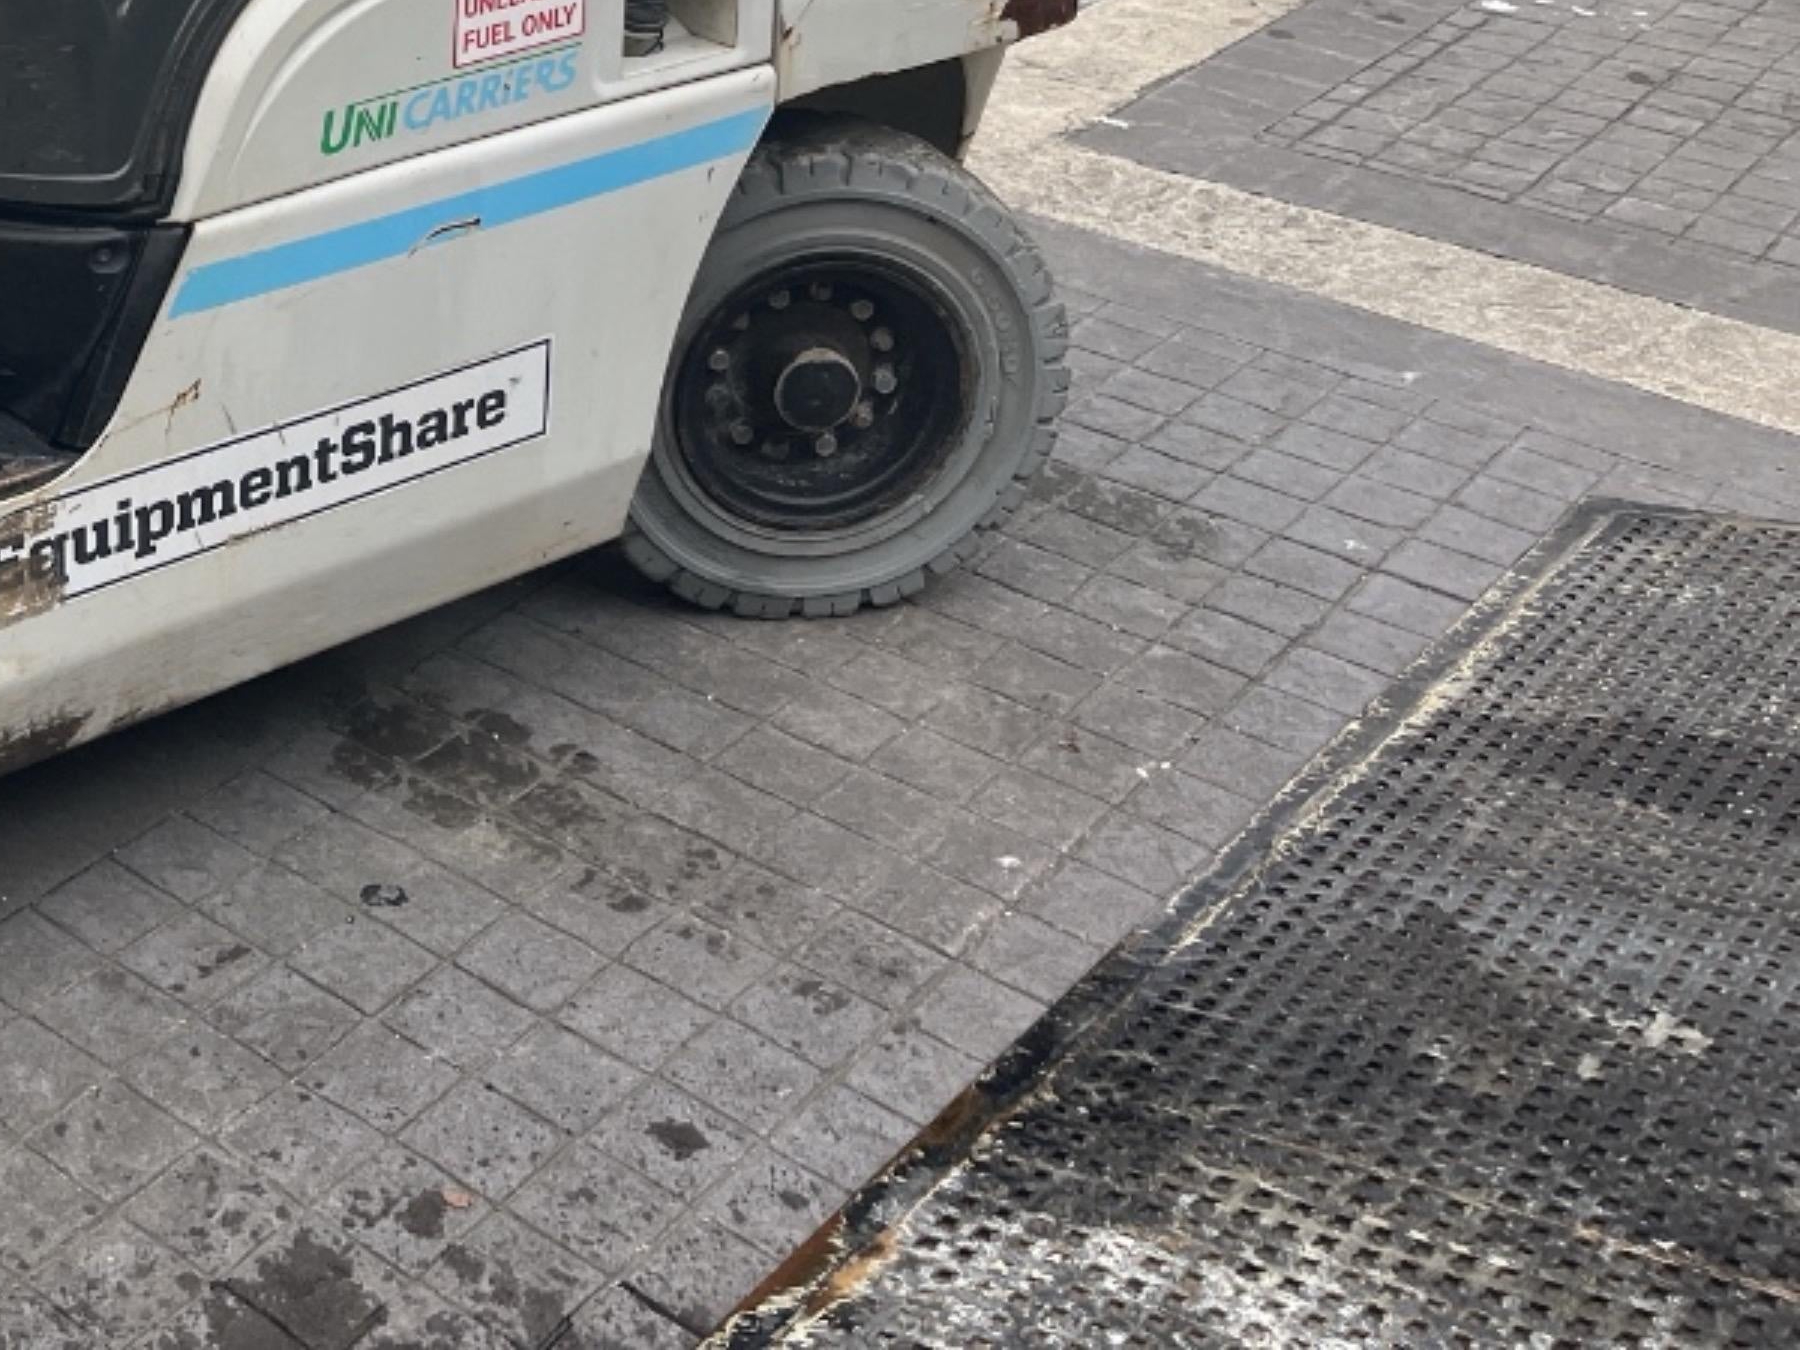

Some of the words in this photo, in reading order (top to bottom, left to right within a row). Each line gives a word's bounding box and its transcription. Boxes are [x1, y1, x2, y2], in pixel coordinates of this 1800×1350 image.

[461, 20, 517, 54] FUEL
[521, 1, 577, 37] ONLY
[319, 49, 578, 156] UNICARRIERS
